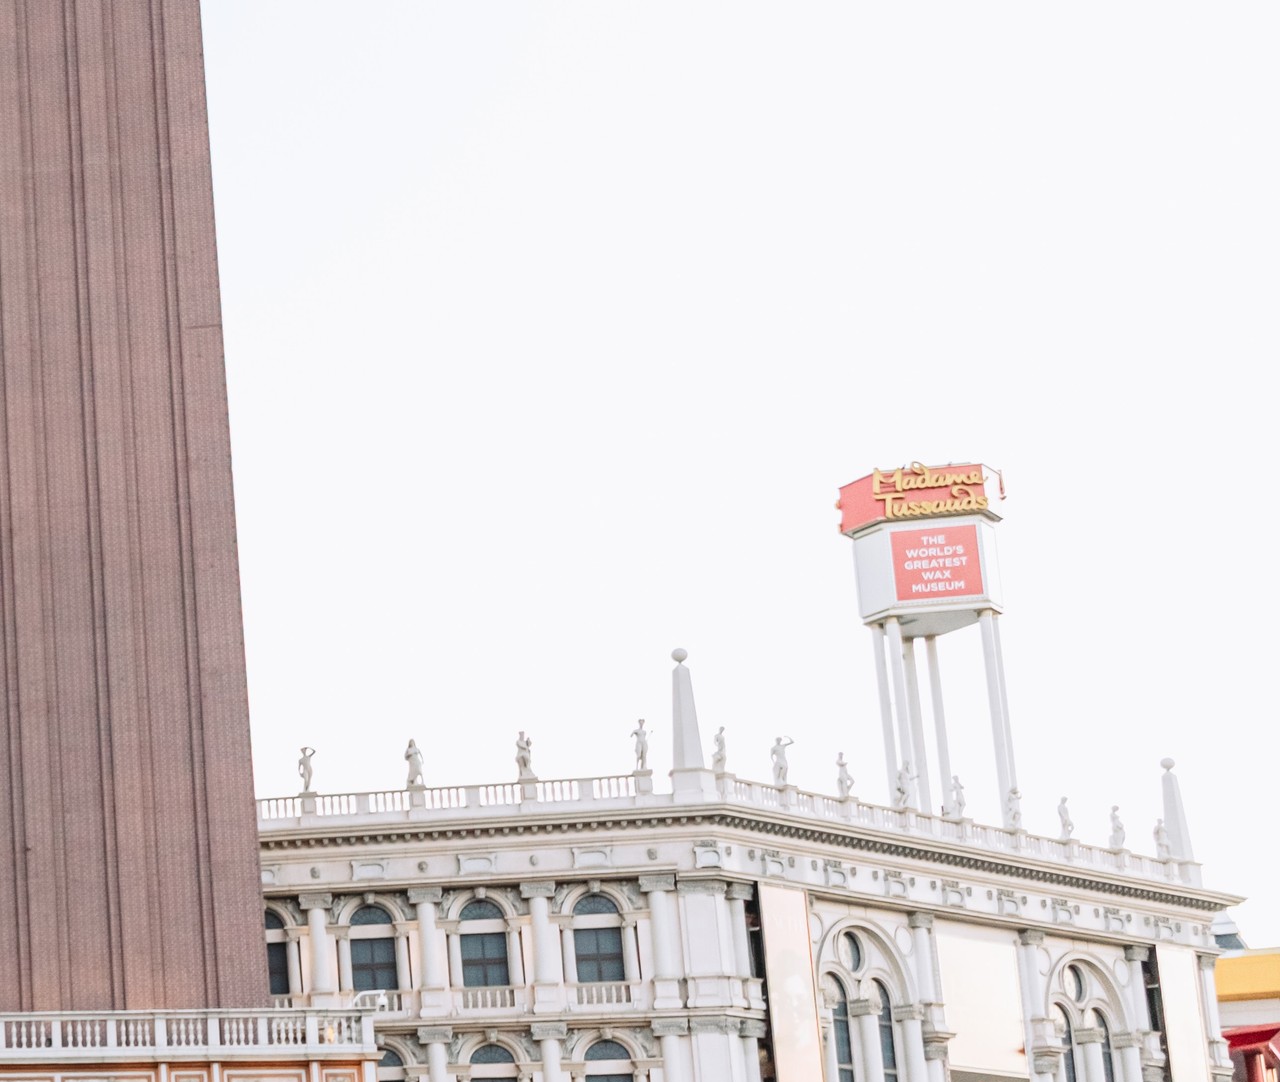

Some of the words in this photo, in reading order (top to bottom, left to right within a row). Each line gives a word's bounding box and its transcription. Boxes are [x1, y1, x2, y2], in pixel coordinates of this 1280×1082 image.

[872, 461, 988, 492] Madame
[872, 485, 988, 518] Tussauds
[921, 535, 946, 545] THE
[905, 545, 964, 558] WORLD'S
[904, 556, 968, 570] GREATEST
[921, 570, 952, 580] WAX
[911, 580, 966, 593] MUSEUM
